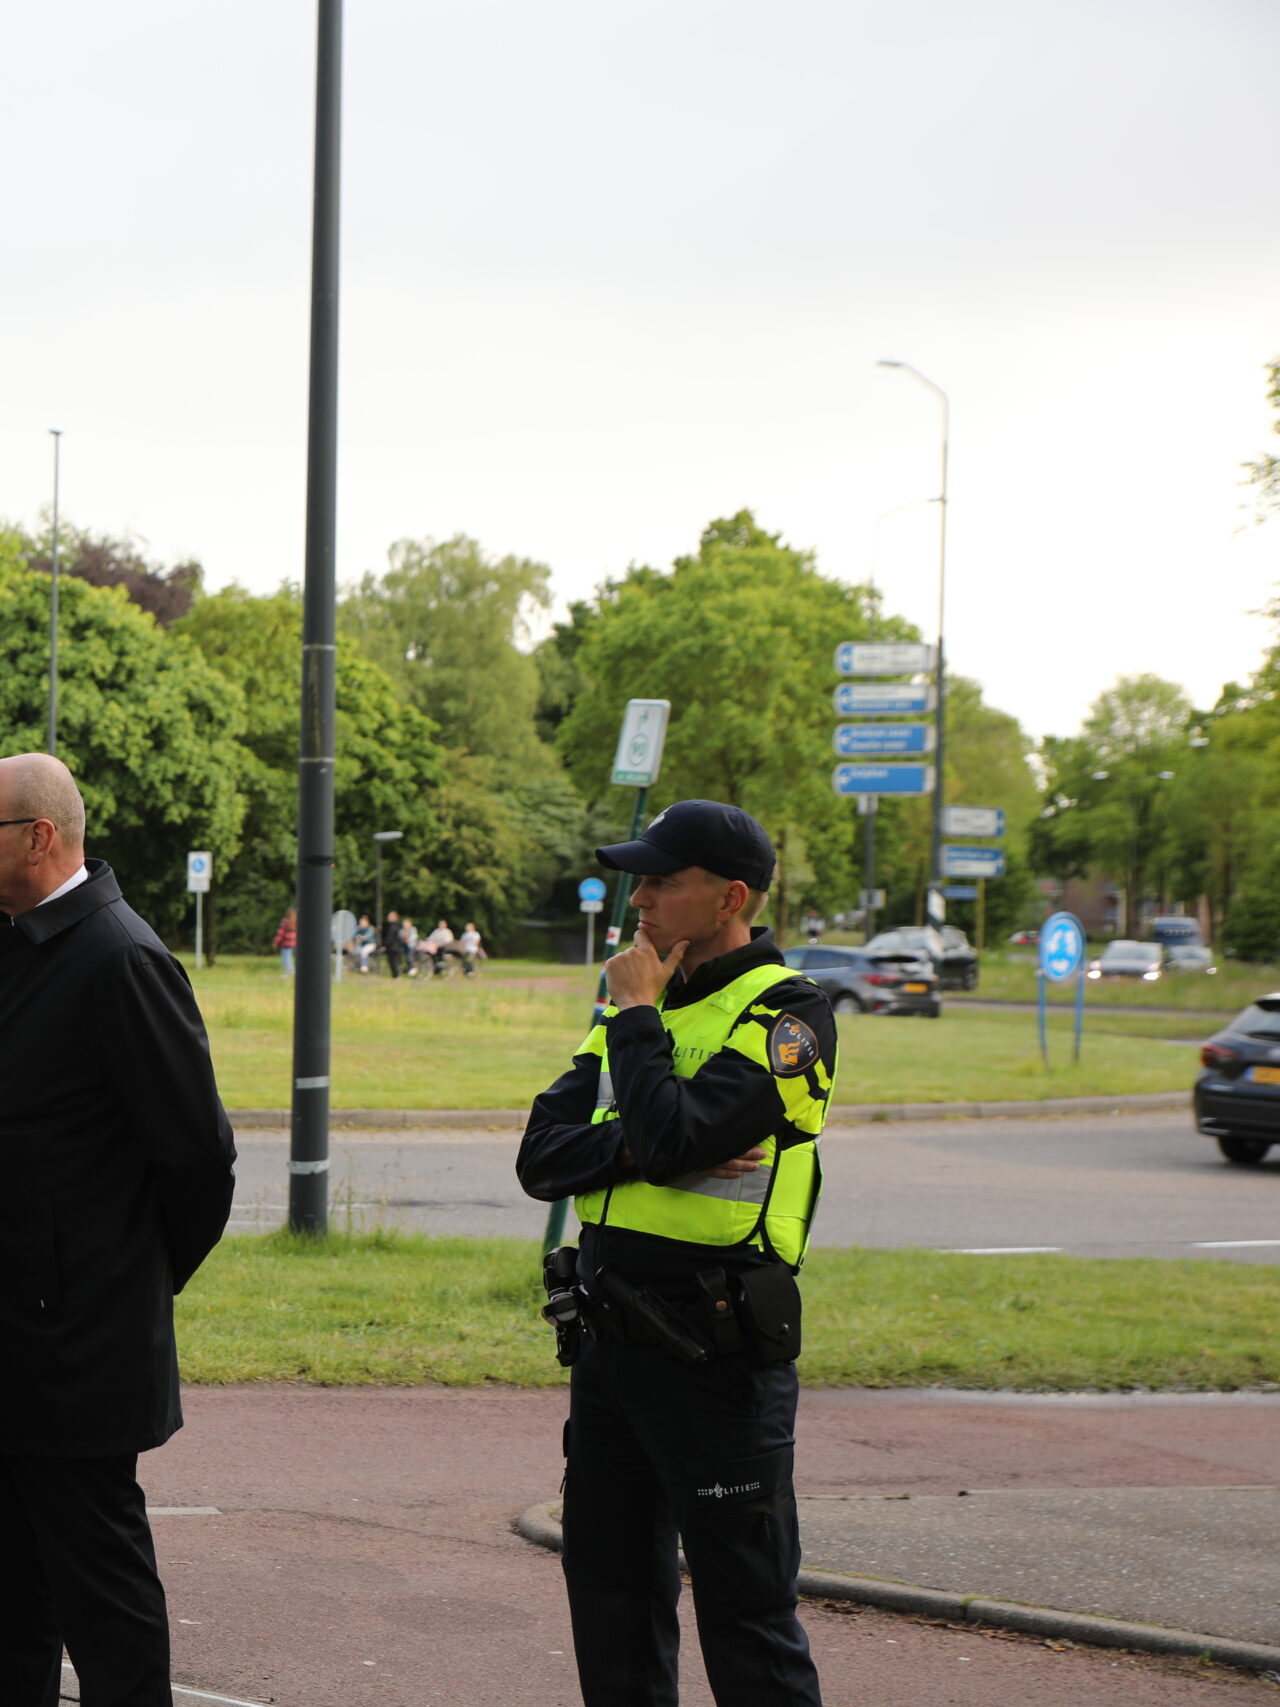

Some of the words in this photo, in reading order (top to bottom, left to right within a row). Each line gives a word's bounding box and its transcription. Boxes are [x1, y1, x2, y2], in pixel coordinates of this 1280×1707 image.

[783, 1021, 814, 1057] POLITIE
[673, 1046, 715, 1060] LITI
[708, 1482, 750, 1498] POLITIE
